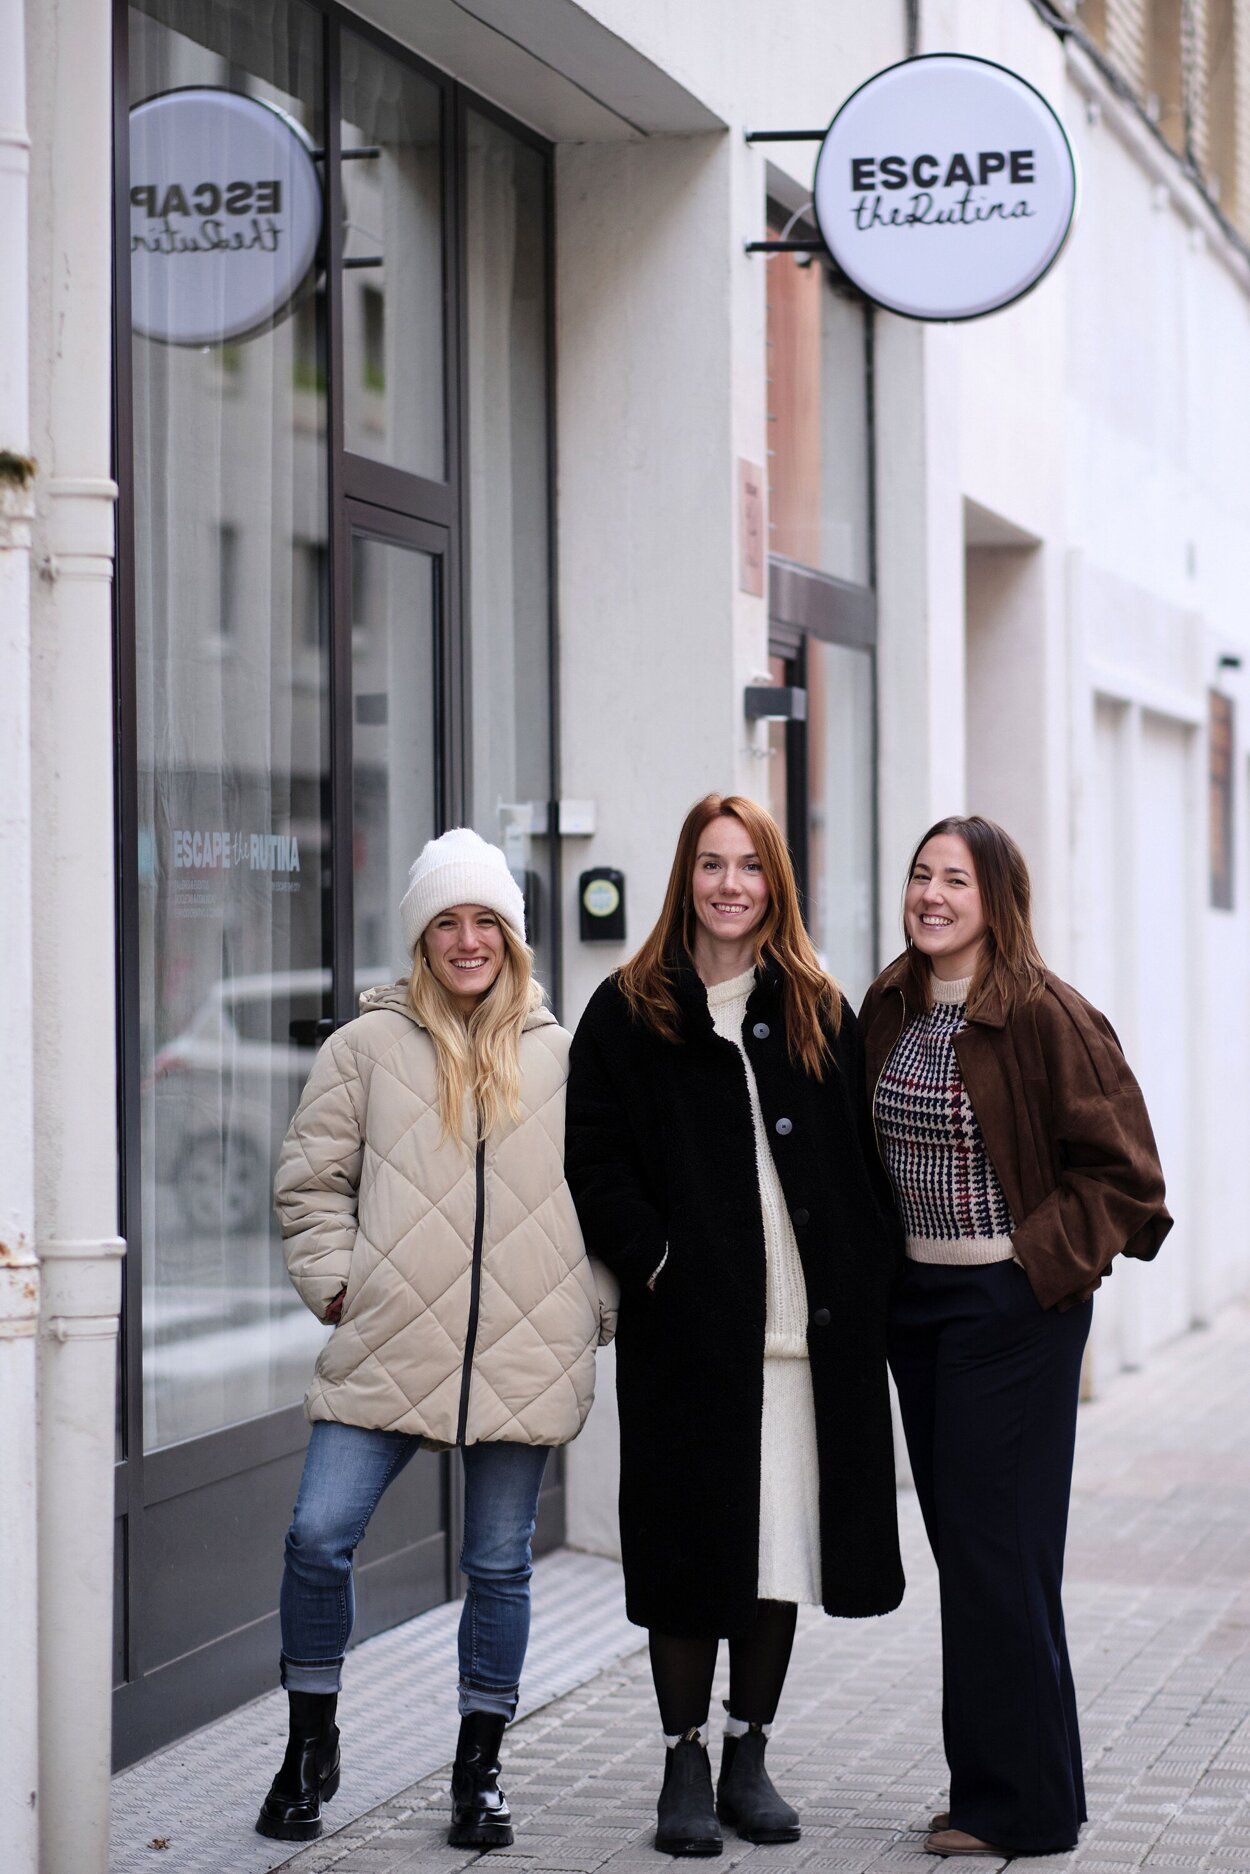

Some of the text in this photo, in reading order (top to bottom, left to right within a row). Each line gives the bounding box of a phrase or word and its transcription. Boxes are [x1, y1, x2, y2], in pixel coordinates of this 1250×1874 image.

[852, 150, 1035, 191] ESCAPE
[173, 830, 300, 872] ESCAPE the RUTINA
